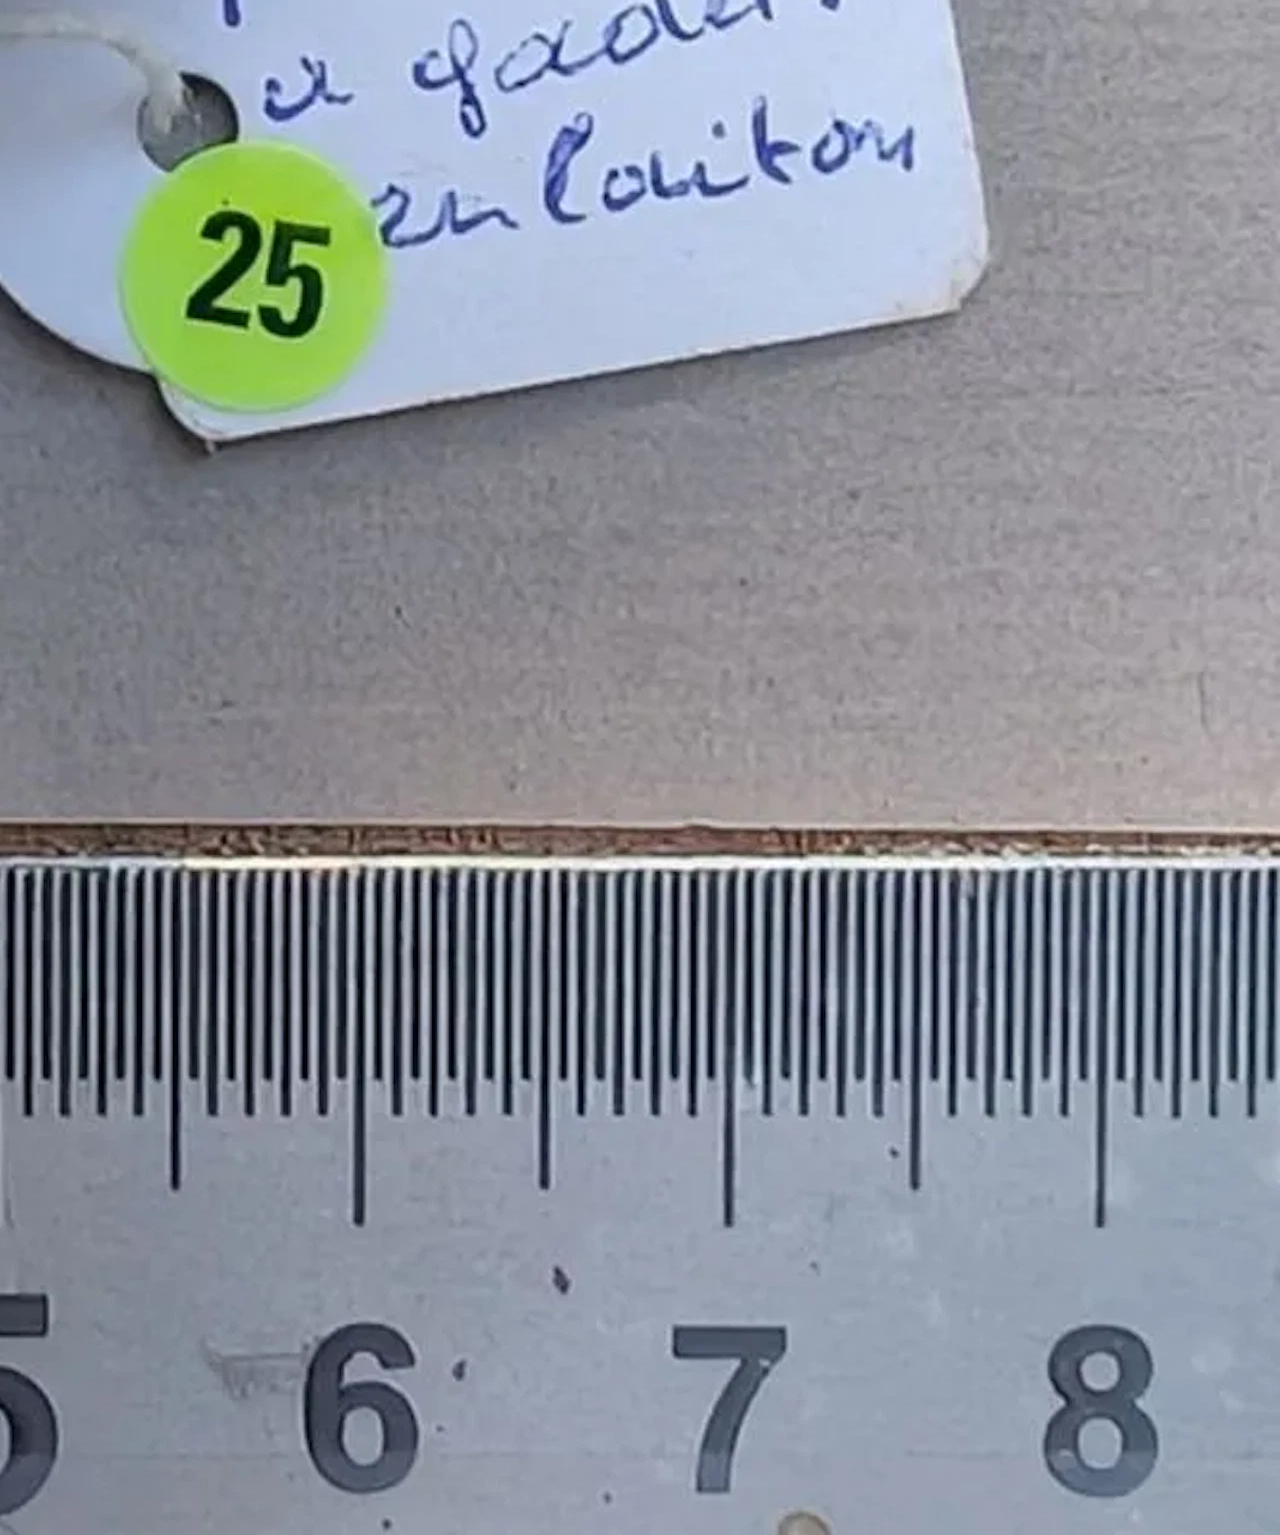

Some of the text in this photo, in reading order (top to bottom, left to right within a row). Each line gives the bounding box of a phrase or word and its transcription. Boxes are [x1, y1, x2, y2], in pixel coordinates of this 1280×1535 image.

[185, 210, 332, 338] 25
[303, 1322, 420, 1494] 6
[671, 1325, 788, 1494] 7
[1042, 1324, 1160, 1497] 8
